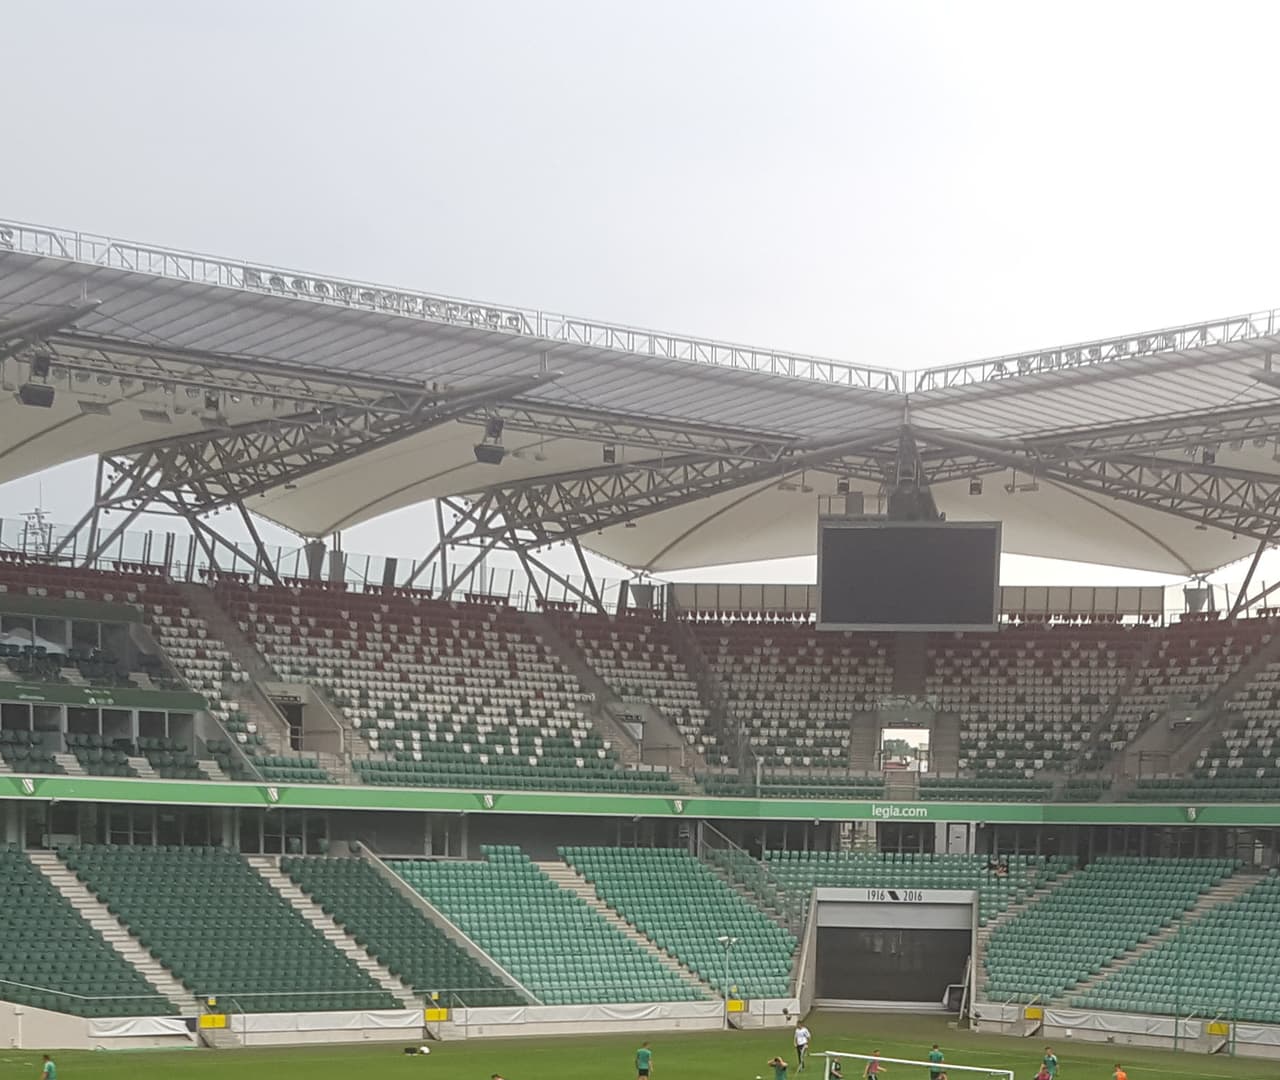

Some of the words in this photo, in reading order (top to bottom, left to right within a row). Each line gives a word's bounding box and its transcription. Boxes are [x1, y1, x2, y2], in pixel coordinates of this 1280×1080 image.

[871, 803, 928, 818] legia.com
[867, 889, 886, 901] 1916
[903, 890, 923, 902] 2016
